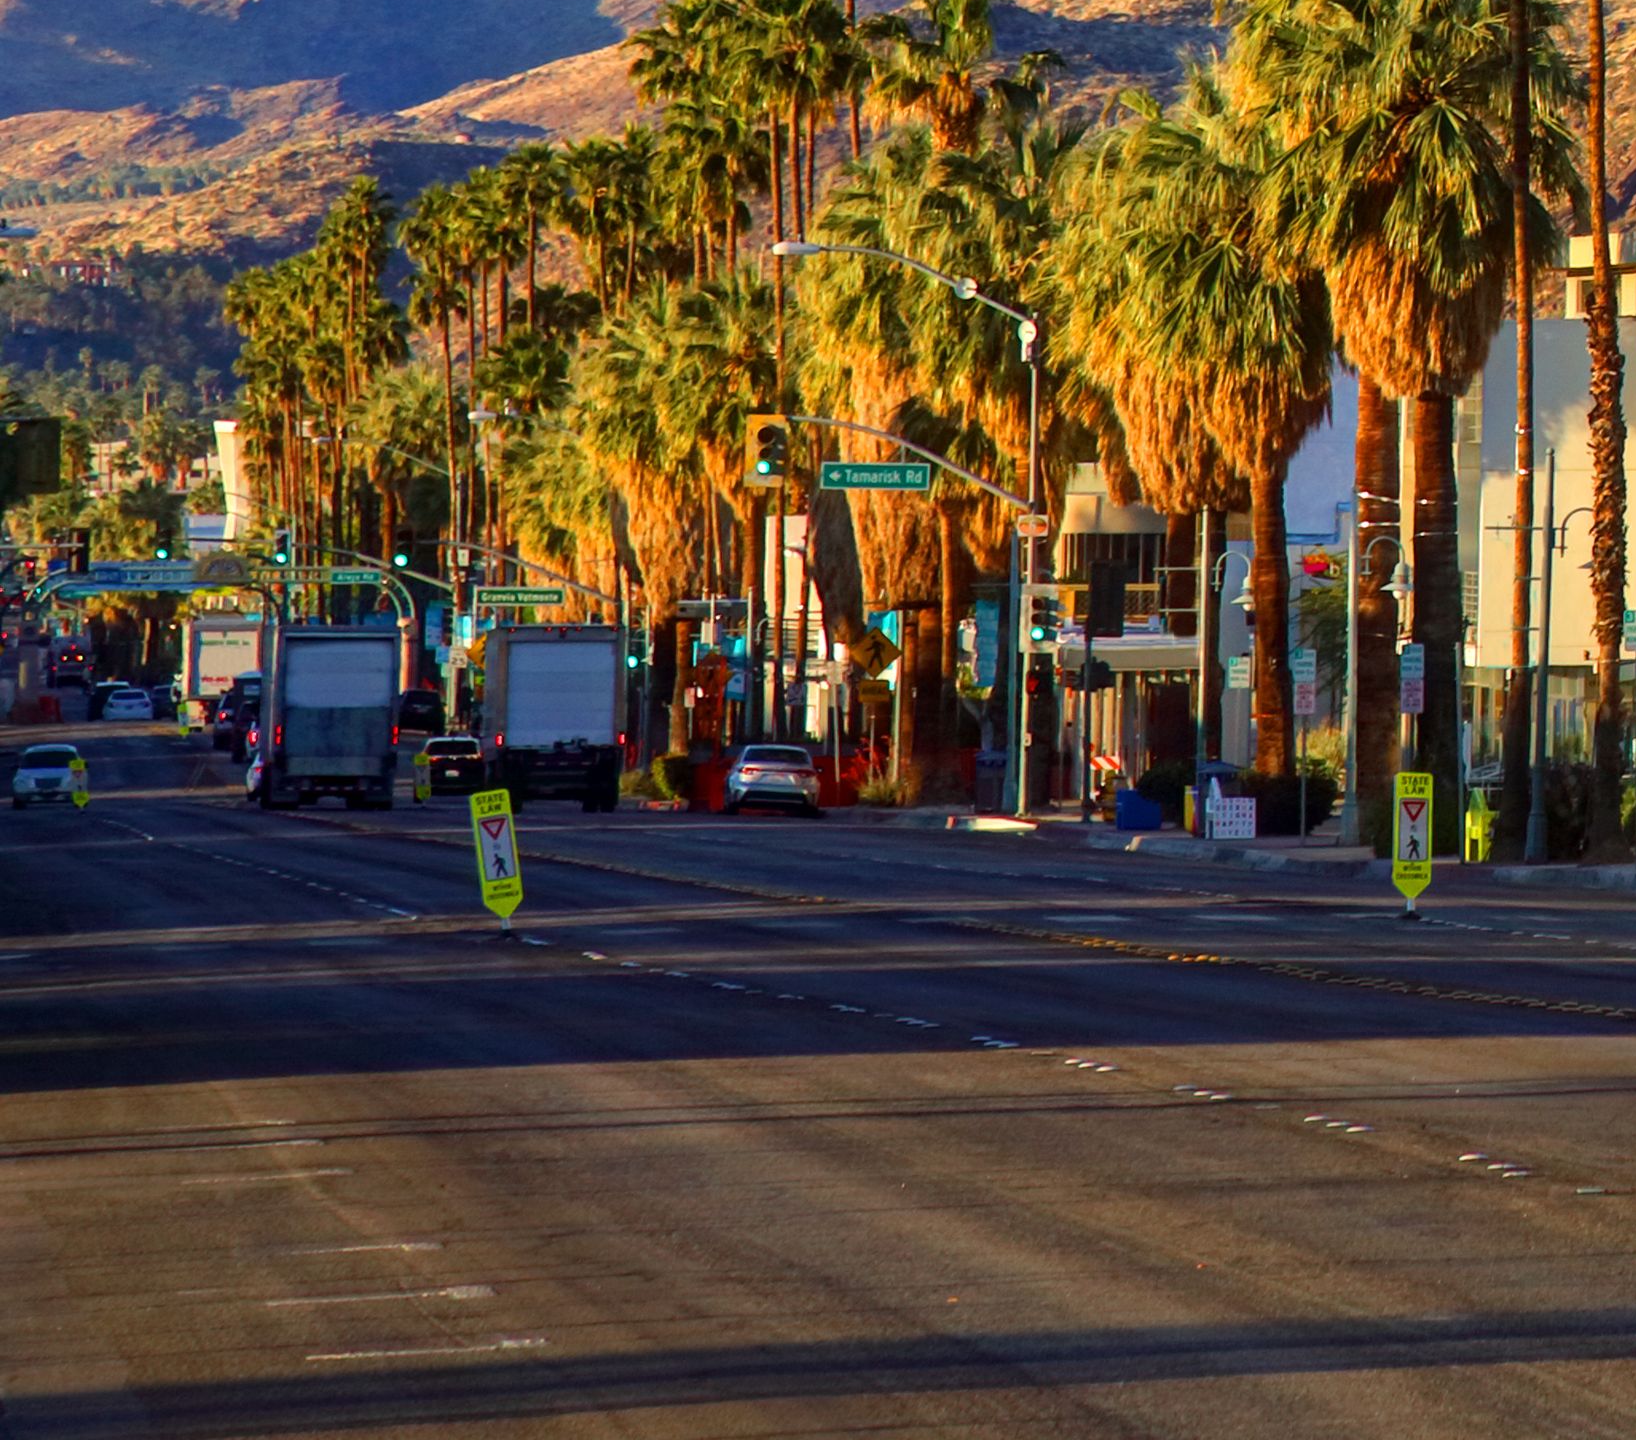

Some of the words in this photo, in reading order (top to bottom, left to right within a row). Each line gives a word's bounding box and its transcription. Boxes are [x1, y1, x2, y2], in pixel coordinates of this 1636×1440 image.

[844, 468, 902, 484] Tamarisk
[905, 469, 923, 484] Rd
[1401, 775, 1430, 786] STATE
[1404, 785, 1426, 795] LAW
[475, 792, 504, 806] STATE
[480, 803, 502, 814] LAW
